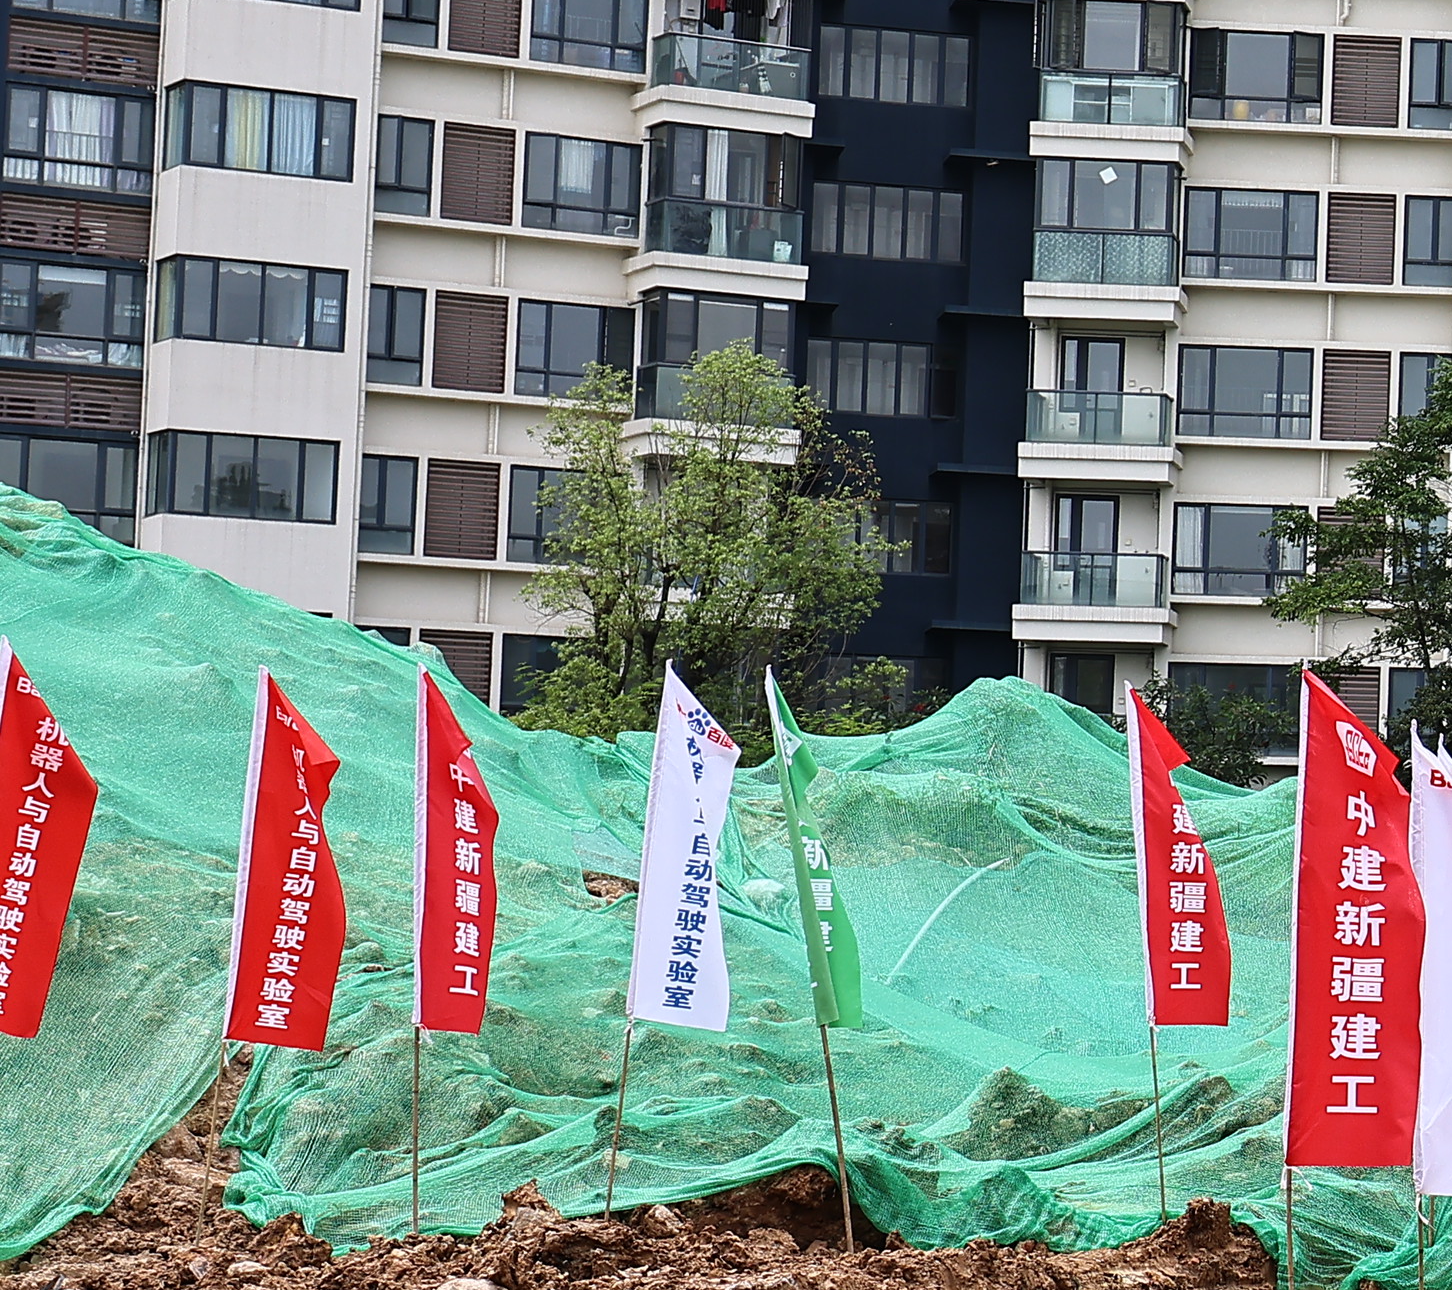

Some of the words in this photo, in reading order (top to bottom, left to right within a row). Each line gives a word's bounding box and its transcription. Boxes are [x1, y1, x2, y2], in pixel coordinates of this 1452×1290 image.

[1326, 791, 1388, 1115] 中建新疆建工
